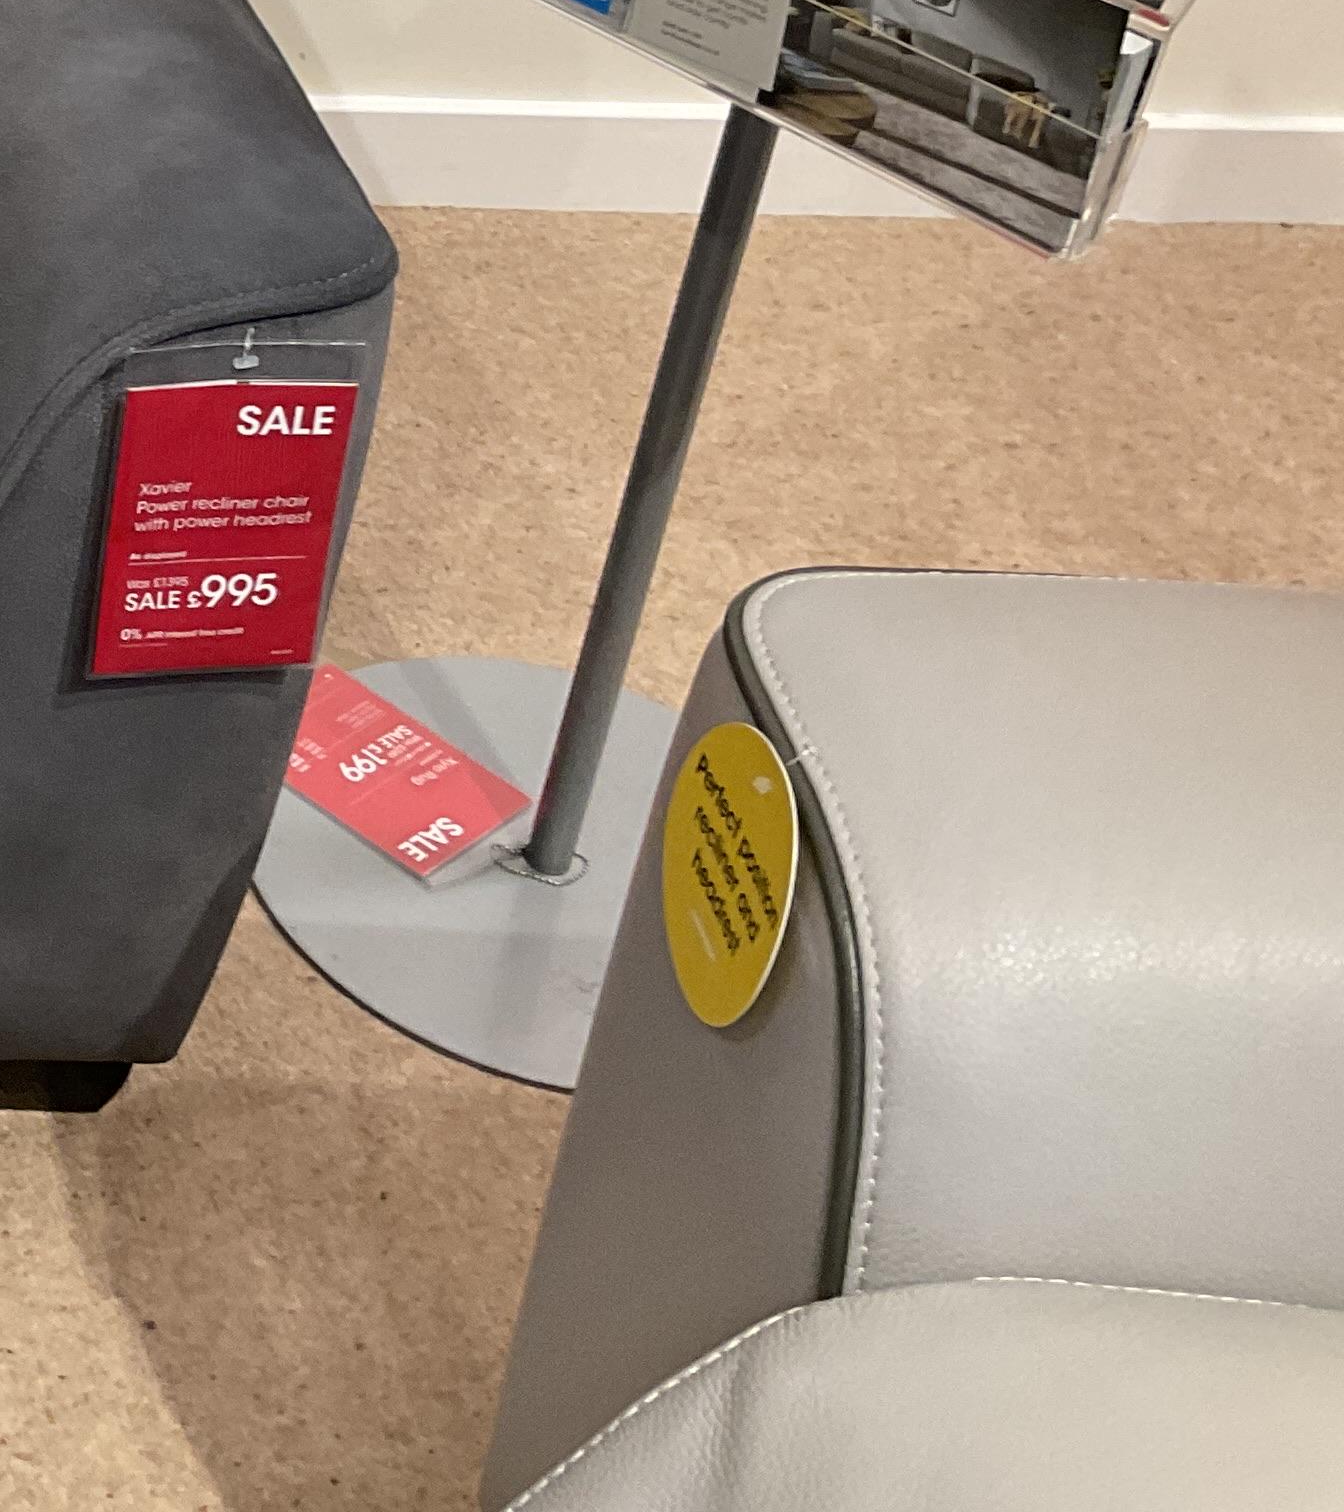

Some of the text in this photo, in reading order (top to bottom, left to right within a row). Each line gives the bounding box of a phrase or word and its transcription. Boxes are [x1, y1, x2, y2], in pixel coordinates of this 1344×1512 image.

[236, 404, 336, 437] SALE
[135, 494, 310, 515] Power recliner chair
[139, 479, 192, 497] Xavier
[134, 510, 313, 532] with power headrest
[124, 572, 278, 612] SALE £995
[377, 725, 413, 750] SALE
[339, 743, 382, 782] £199
[695, 752, 743, 840] Perfect
[397, 817, 465, 863] SALE
[737, 892, 759, 943] and
